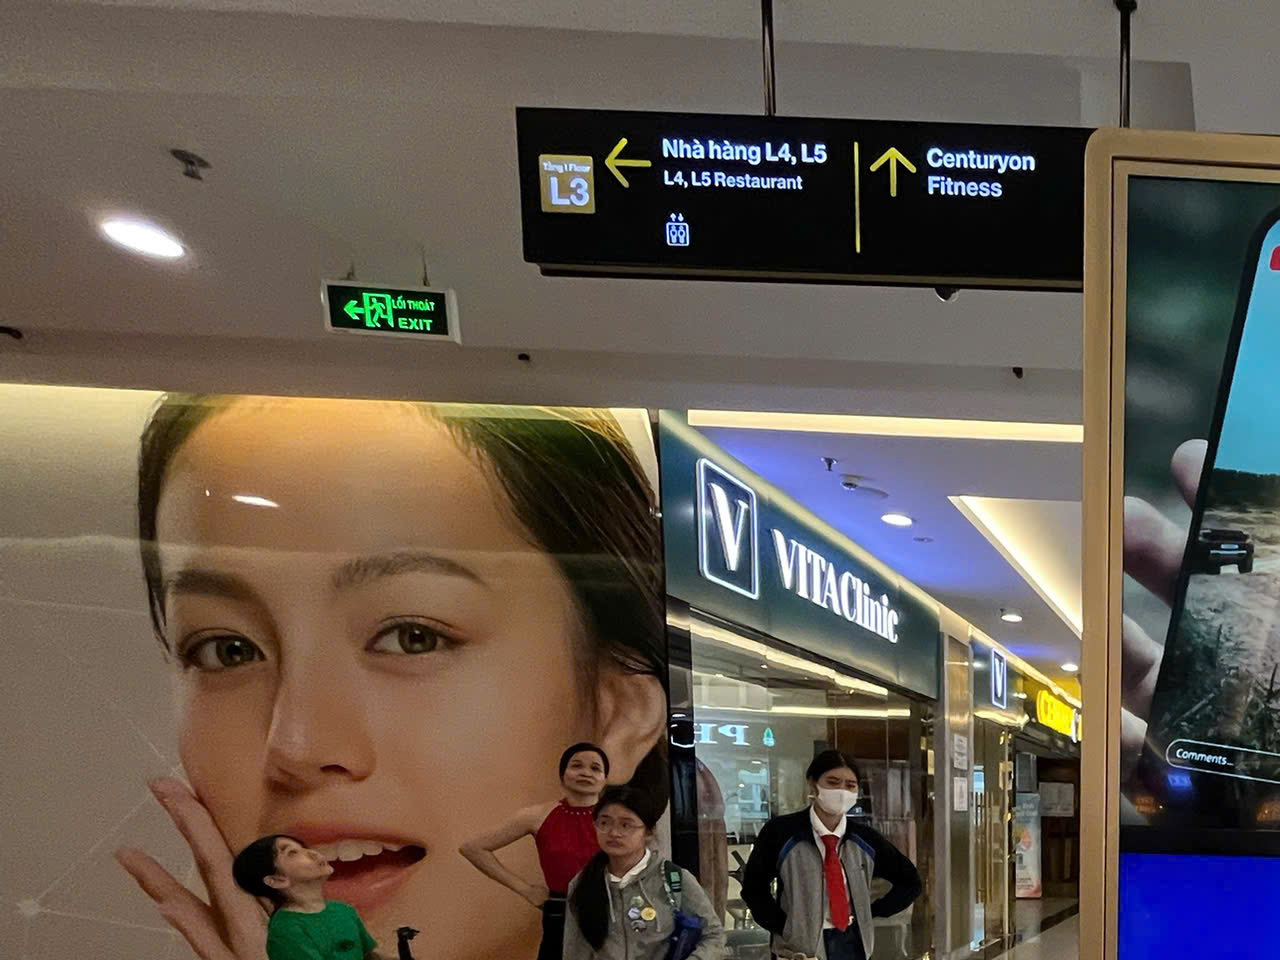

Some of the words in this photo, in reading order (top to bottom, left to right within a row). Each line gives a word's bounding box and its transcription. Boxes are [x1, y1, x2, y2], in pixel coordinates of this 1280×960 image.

[662, 138, 705, 160] Nhà
[708, 139, 762, 166] hàng
[765, 142, 798, 166] L4,
[801, 143, 828, 164] L5
[926, 147, 1036, 174] Centuryon
[550, 176, 590, 207] L3
[663, 169, 689, 189] L4,
[691, 170, 712, 188] L5
[714, 171, 804, 190] Restaurant
[927, 175, 1003, 198] Fitness
[406, 298, 436, 312] THOÁT
[398, 317, 433, 331] EXIT
[708, 482, 750, 572] V
[770, 528, 899, 644] VITAClinic
